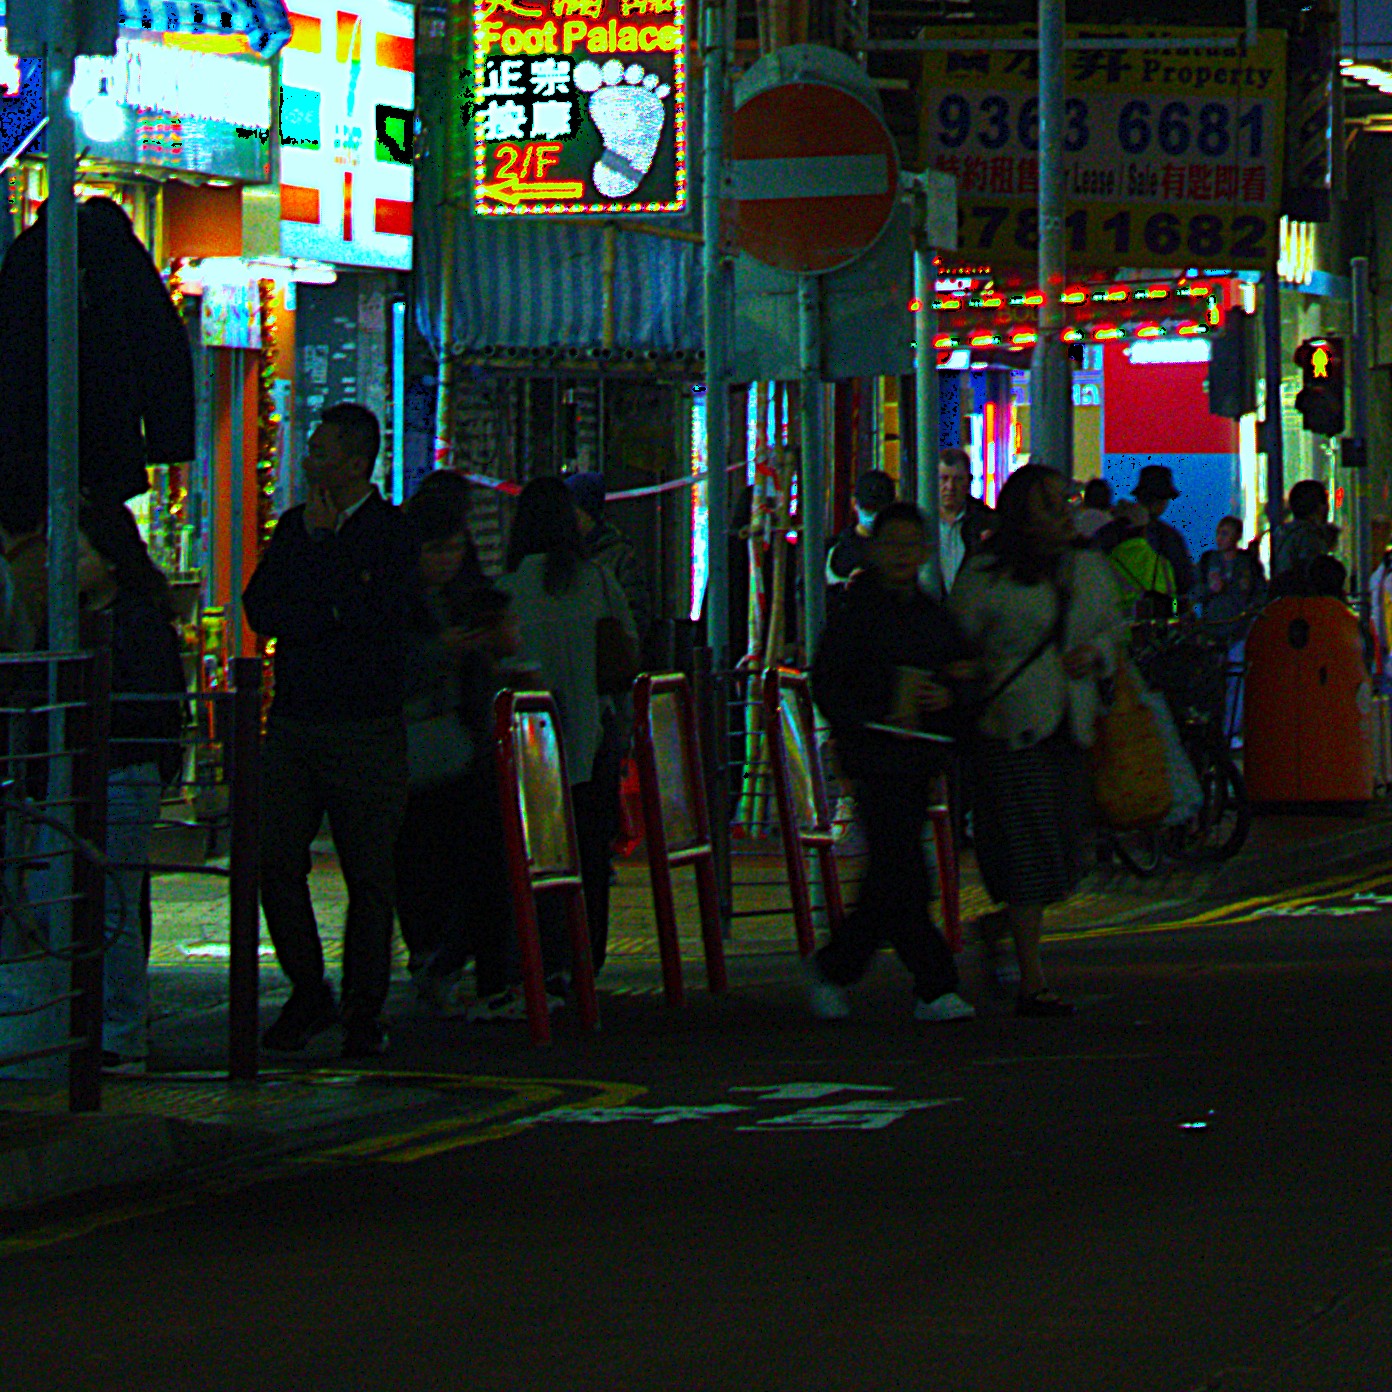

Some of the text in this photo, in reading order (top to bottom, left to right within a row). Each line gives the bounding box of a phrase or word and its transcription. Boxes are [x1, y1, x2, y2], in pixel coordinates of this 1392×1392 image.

[481, 19, 681, 55] Foot Palace
[1142, 58, 1274, 90] Property
[938, 93, 1265, 158] 9363 6681
[495, 142, 563, 180] 2/F
[957, 206, 1268, 259] 7811682
